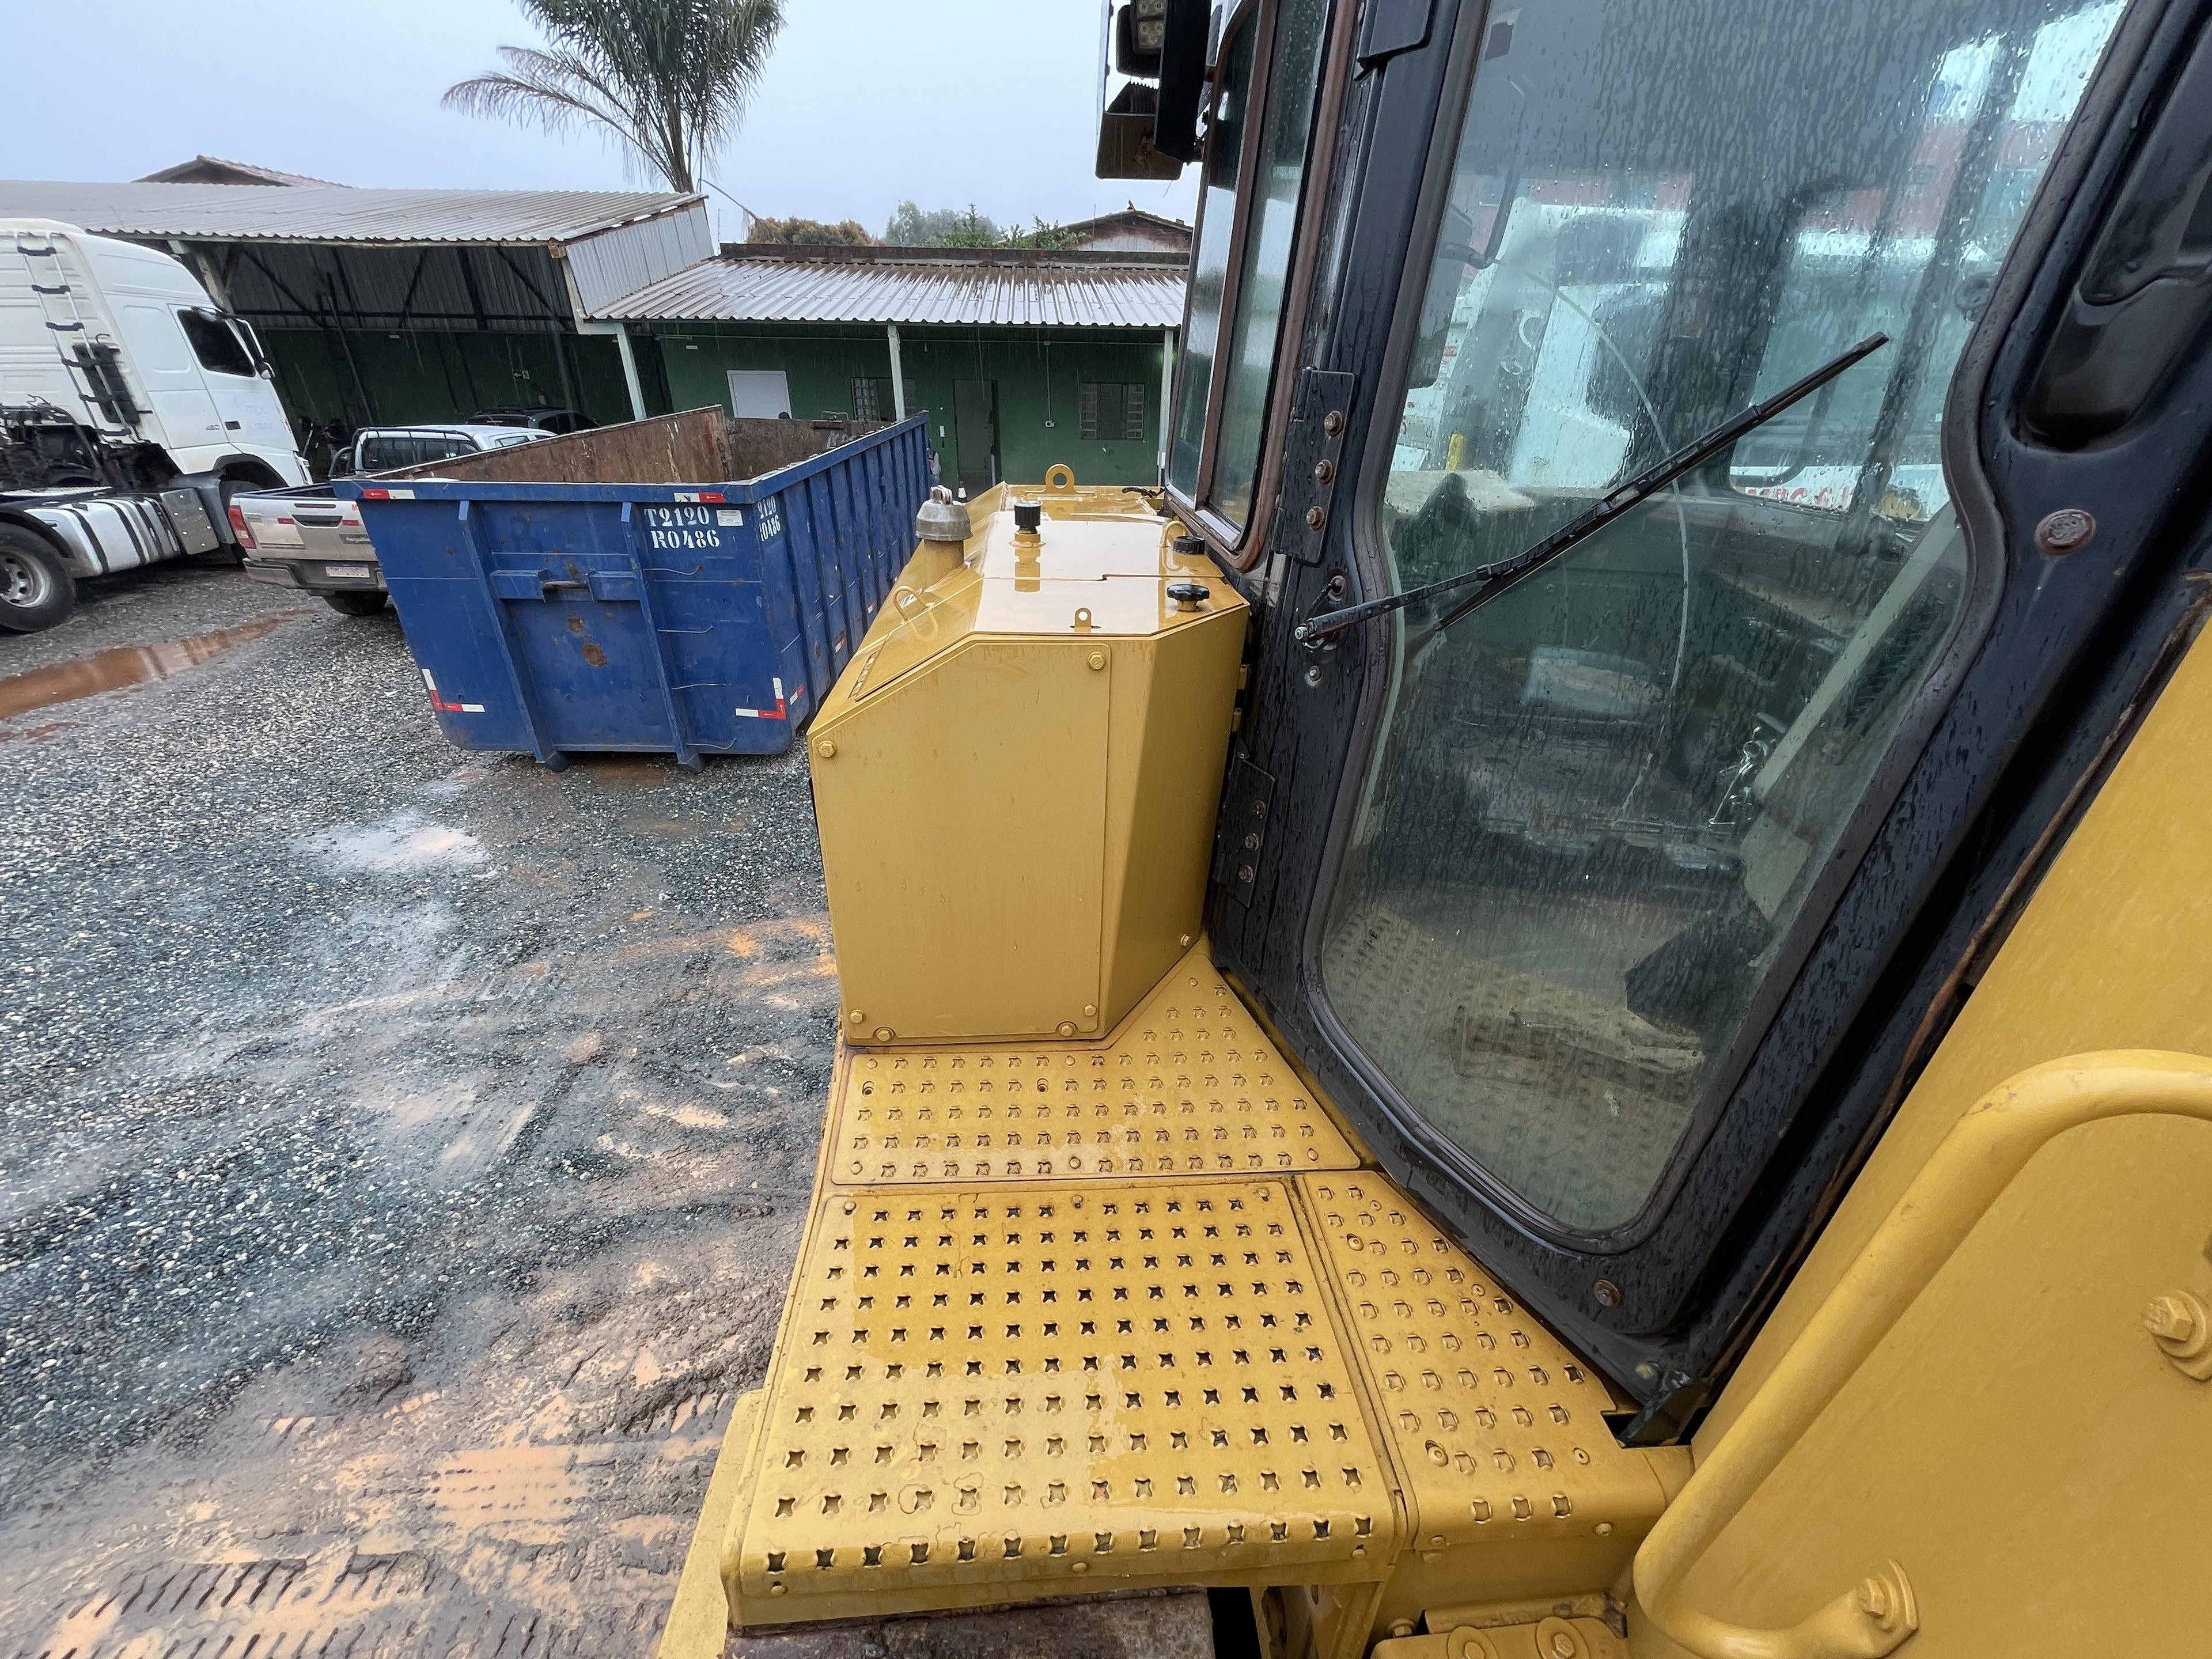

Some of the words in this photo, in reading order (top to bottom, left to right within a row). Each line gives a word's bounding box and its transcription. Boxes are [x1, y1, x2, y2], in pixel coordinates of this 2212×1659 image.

[643, 506, 710, 527] T2120
[757, 496, 777, 519] 2120
[759, 514, 781, 541] 0486
[650, 529, 720, 549] R0486
